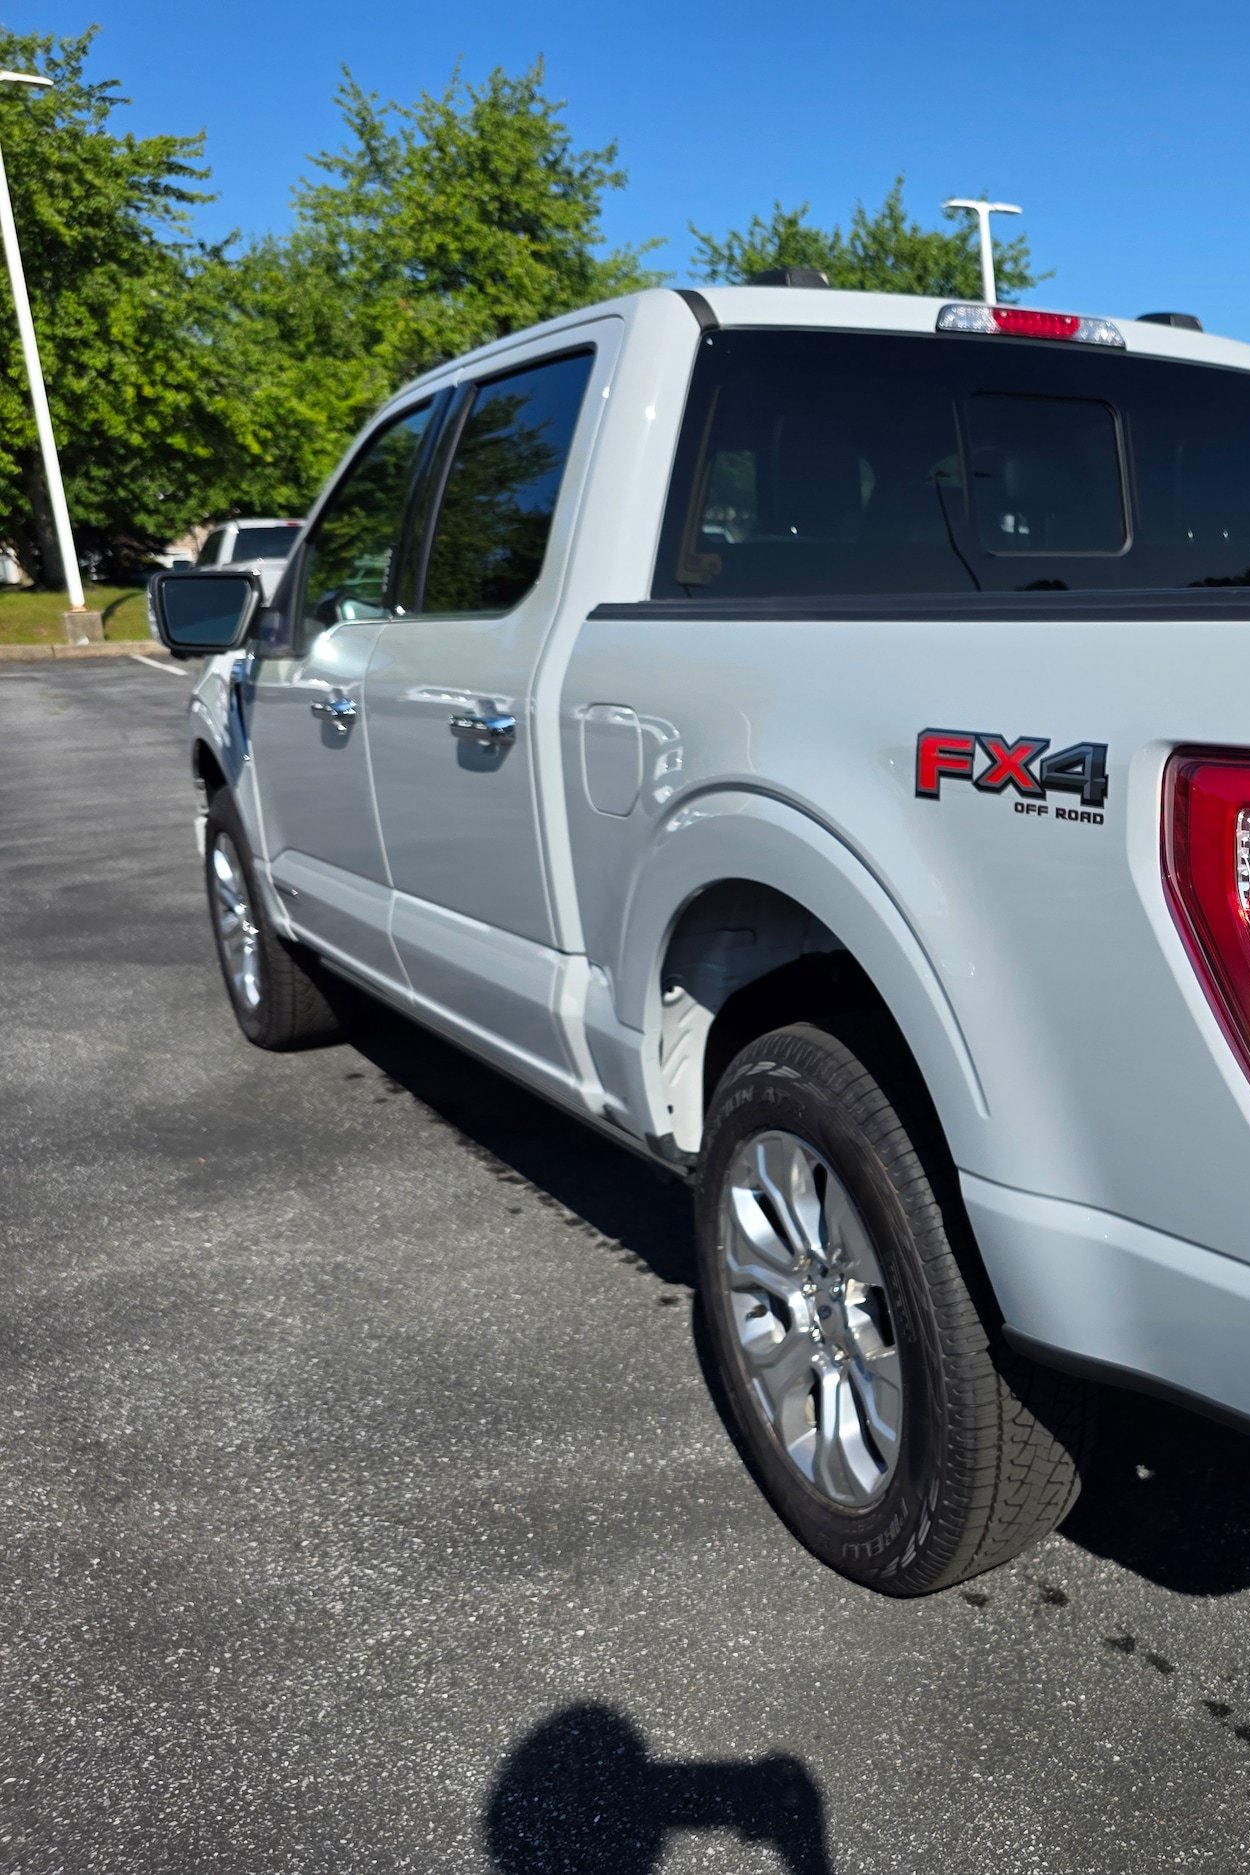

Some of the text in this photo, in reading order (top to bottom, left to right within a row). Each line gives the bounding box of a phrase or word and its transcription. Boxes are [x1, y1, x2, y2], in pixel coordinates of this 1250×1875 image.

[915, 727, 1109, 809] FX4
[1014, 802, 1104, 825] OFF ROAD
